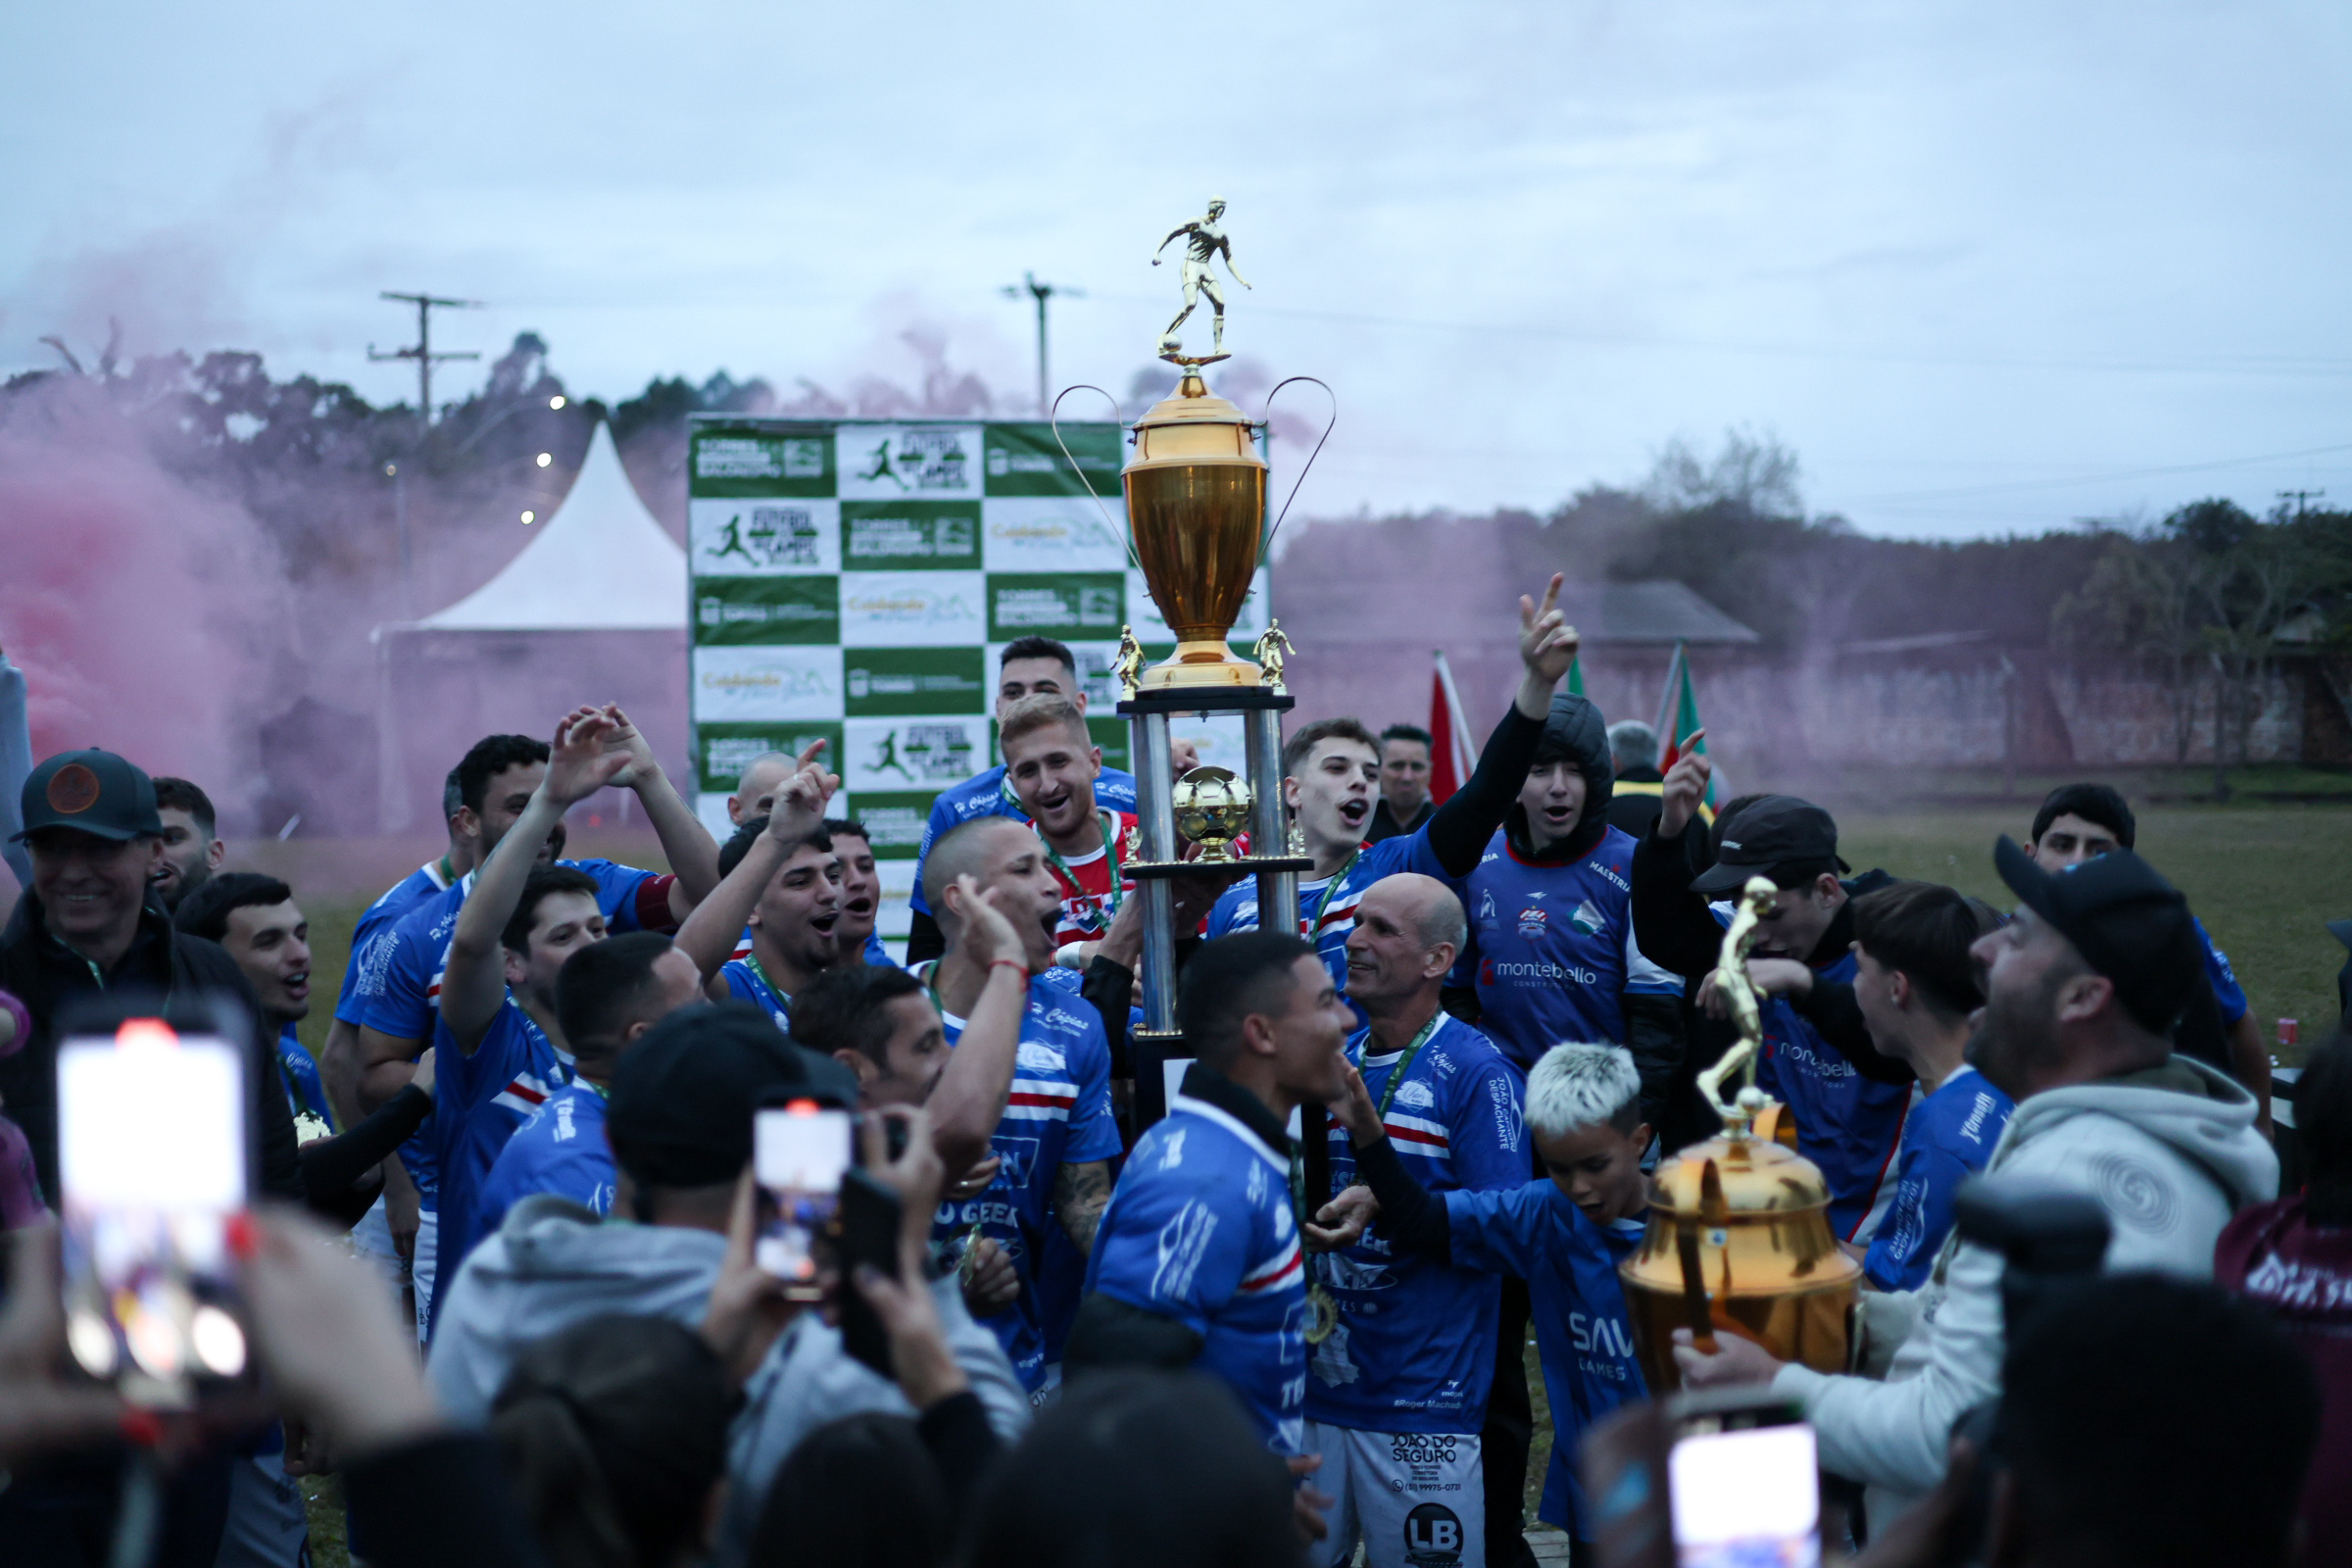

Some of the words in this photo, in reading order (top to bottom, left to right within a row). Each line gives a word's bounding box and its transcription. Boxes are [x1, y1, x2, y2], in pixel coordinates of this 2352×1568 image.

[1497, 960, 1596, 985] montebello
[1489, 1079, 1509, 1151] DESPACHANTE
[1433, 1435, 1456, 1448] DO
[1392, 1448, 1457, 1463] SEGURO
[1409, 1518, 1458, 1549] LB
